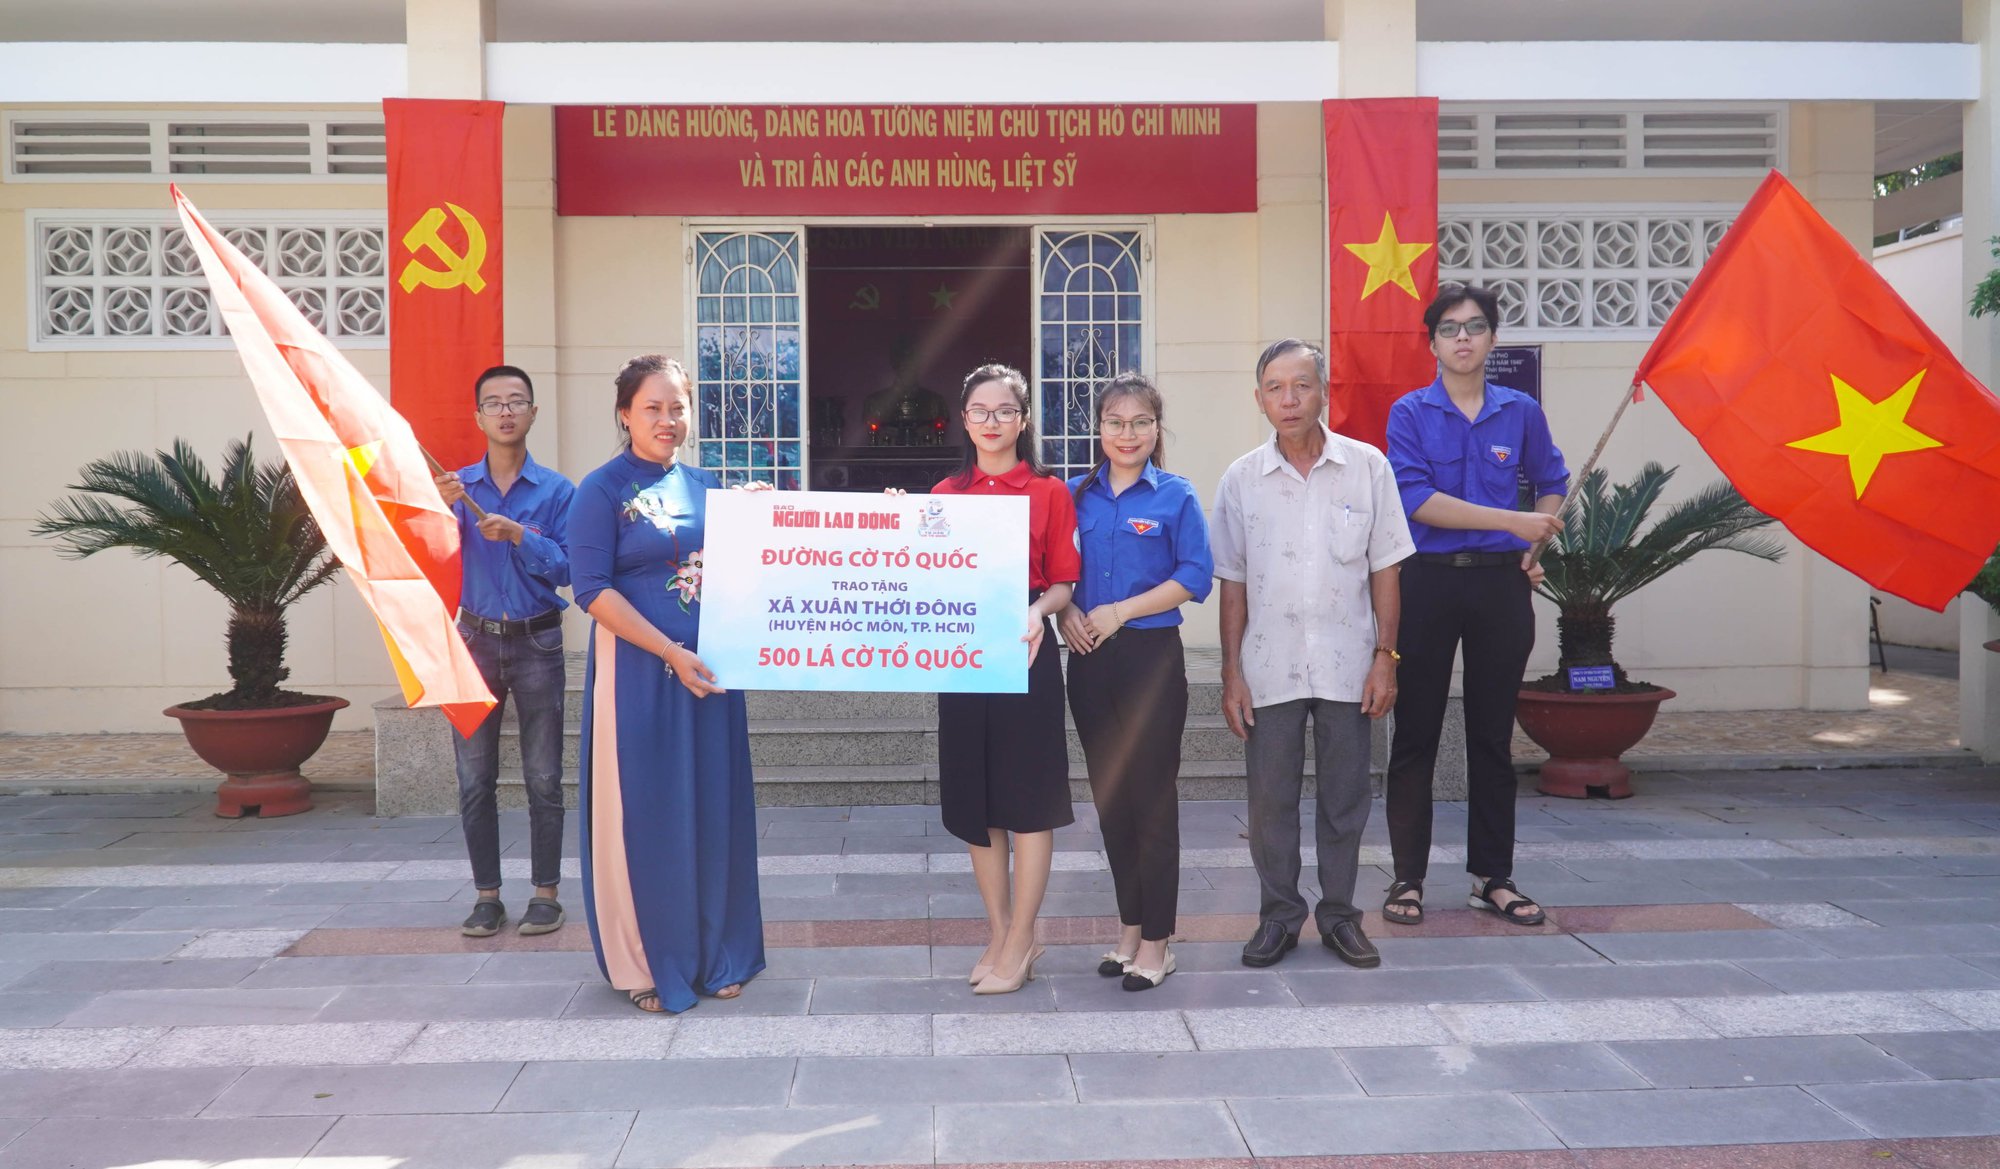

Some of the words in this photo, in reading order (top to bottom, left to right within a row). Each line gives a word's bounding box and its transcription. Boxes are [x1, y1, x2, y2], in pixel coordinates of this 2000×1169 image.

[626, 105, 680, 137] DÂNG
[686, 105, 758, 142] HƯƠNG,
[765, 105, 819, 137] DÂNG
[826, 108, 865, 137] HOA
[944, 105, 994, 143] NIỆM
[1046, 108, 1091, 143] TỊCH
[1132, 104, 1164, 136] CHÍ
[1171, 107, 1221, 136] MINH
[740, 153, 766, 187] VÀ
[772, 159, 805, 187] TRI
[811, 152, 839, 187] ÂN
[845, 152, 884, 187] CÁC
[890, 159, 930, 187] ANH
[937, 152, 996, 192] HÙNG,
[1003, 152, 1046, 192] LIỆT
[1053, 152, 1078, 187] SỸ
[824, 511, 854, 529] LAO
[858, 511, 900, 531] ĐỘNG
[761, 547, 843, 567] ĐƯỜNG
[848, 548, 879, 568] CỜ
[882, 546, 910, 568] TỔ
[915, 547, 978, 570] QUỐC
[832, 581, 869, 591] TRAO
[872, 579, 908, 593] TẶNG
[768, 597, 796, 614] XÃ
[801, 597, 858, 615] XUÂN
[862, 598, 910, 615] THỚI
[915, 599, 977, 616] ĐÔNG
[768, 618, 826, 633] (HUYỆN
[829, 618, 863, 632] HÓC
[866, 619, 908, 634] MÔN,
[911, 622, 932, 633] TP.
[934, 622, 975, 634] HCM)
[758, 647, 801, 667] 500
[806, 643, 835, 667] LÁ
[841, 643, 874, 668] CỜ
[878, 641, 909, 668] TỔ
[914, 643, 983, 671] QUỐC
